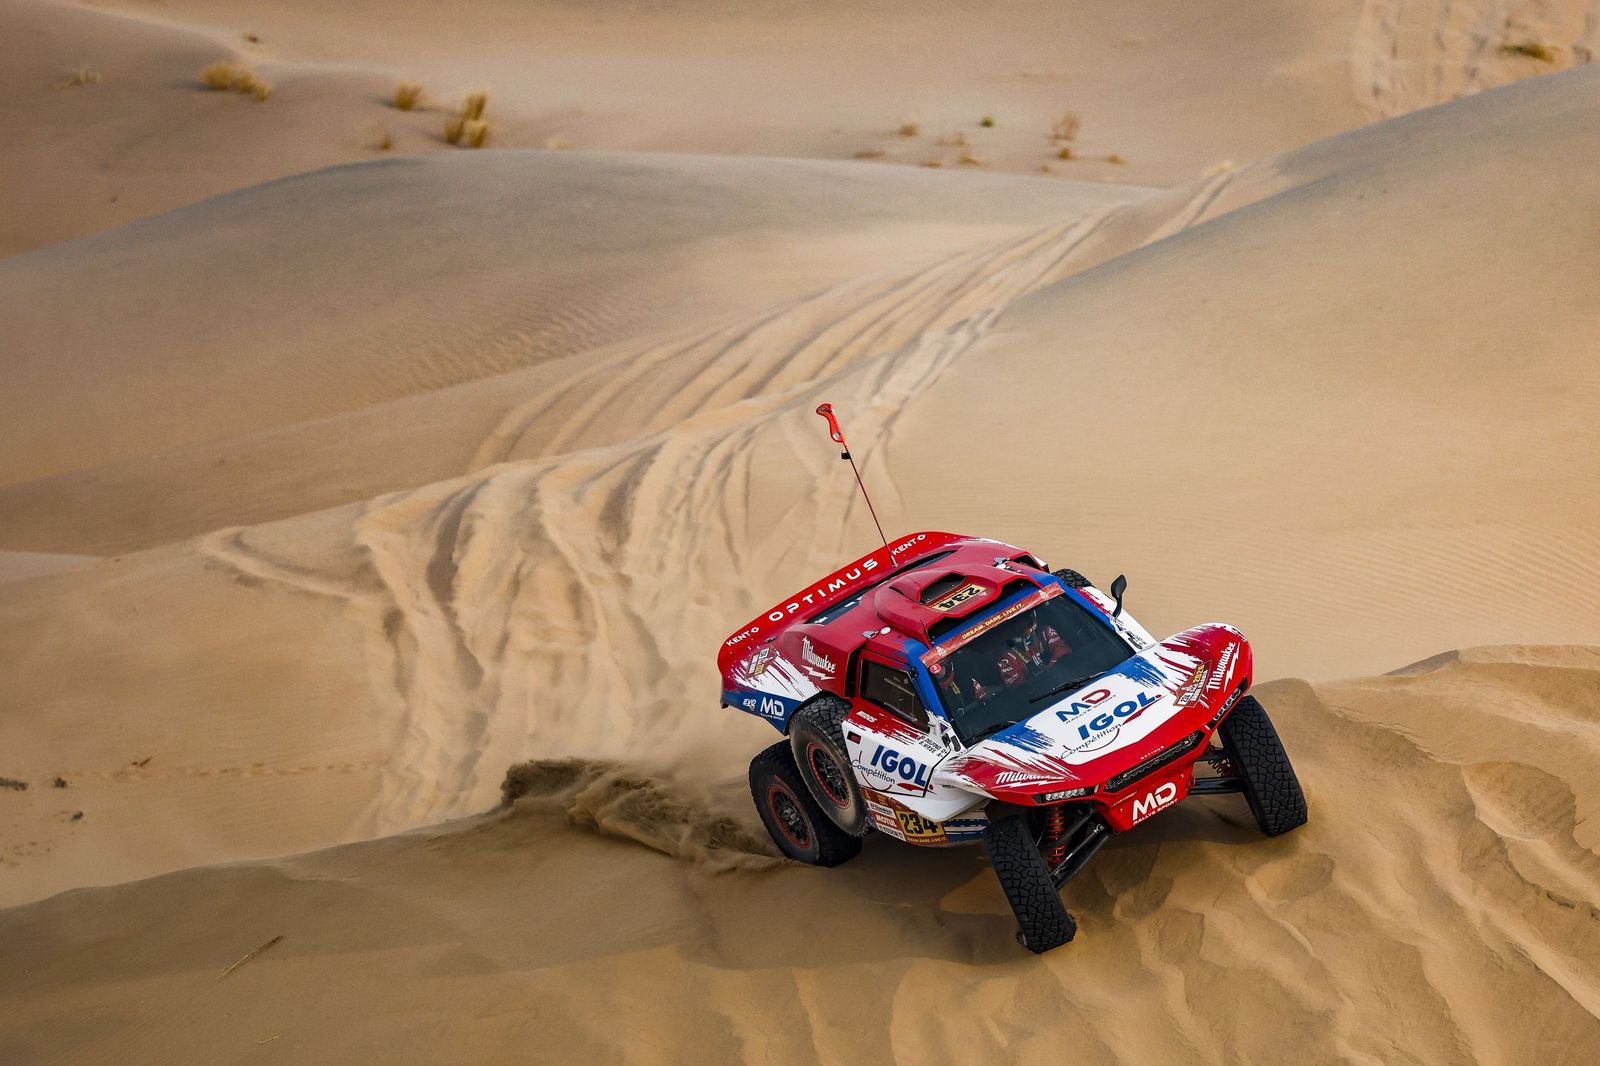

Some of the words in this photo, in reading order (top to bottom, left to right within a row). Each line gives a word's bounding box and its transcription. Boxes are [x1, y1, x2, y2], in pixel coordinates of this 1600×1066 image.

[768, 558, 878, 622] OPTIMUS
[938, 587, 981, 608] 234
[801, 636, 836, 674] Milwaukee
[1206, 641, 1237, 693] Milwaukee
[760, 696, 785, 717] MD
[1056, 688, 1111, 722] MD
[1060, 723, 1122, 759] Compétition
[851, 759, 896, 784] Compétition
[1132, 782, 1177, 821] MD
[1156, 798, 1178, 812] SPORT
[899, 813, 938, 835] 234
